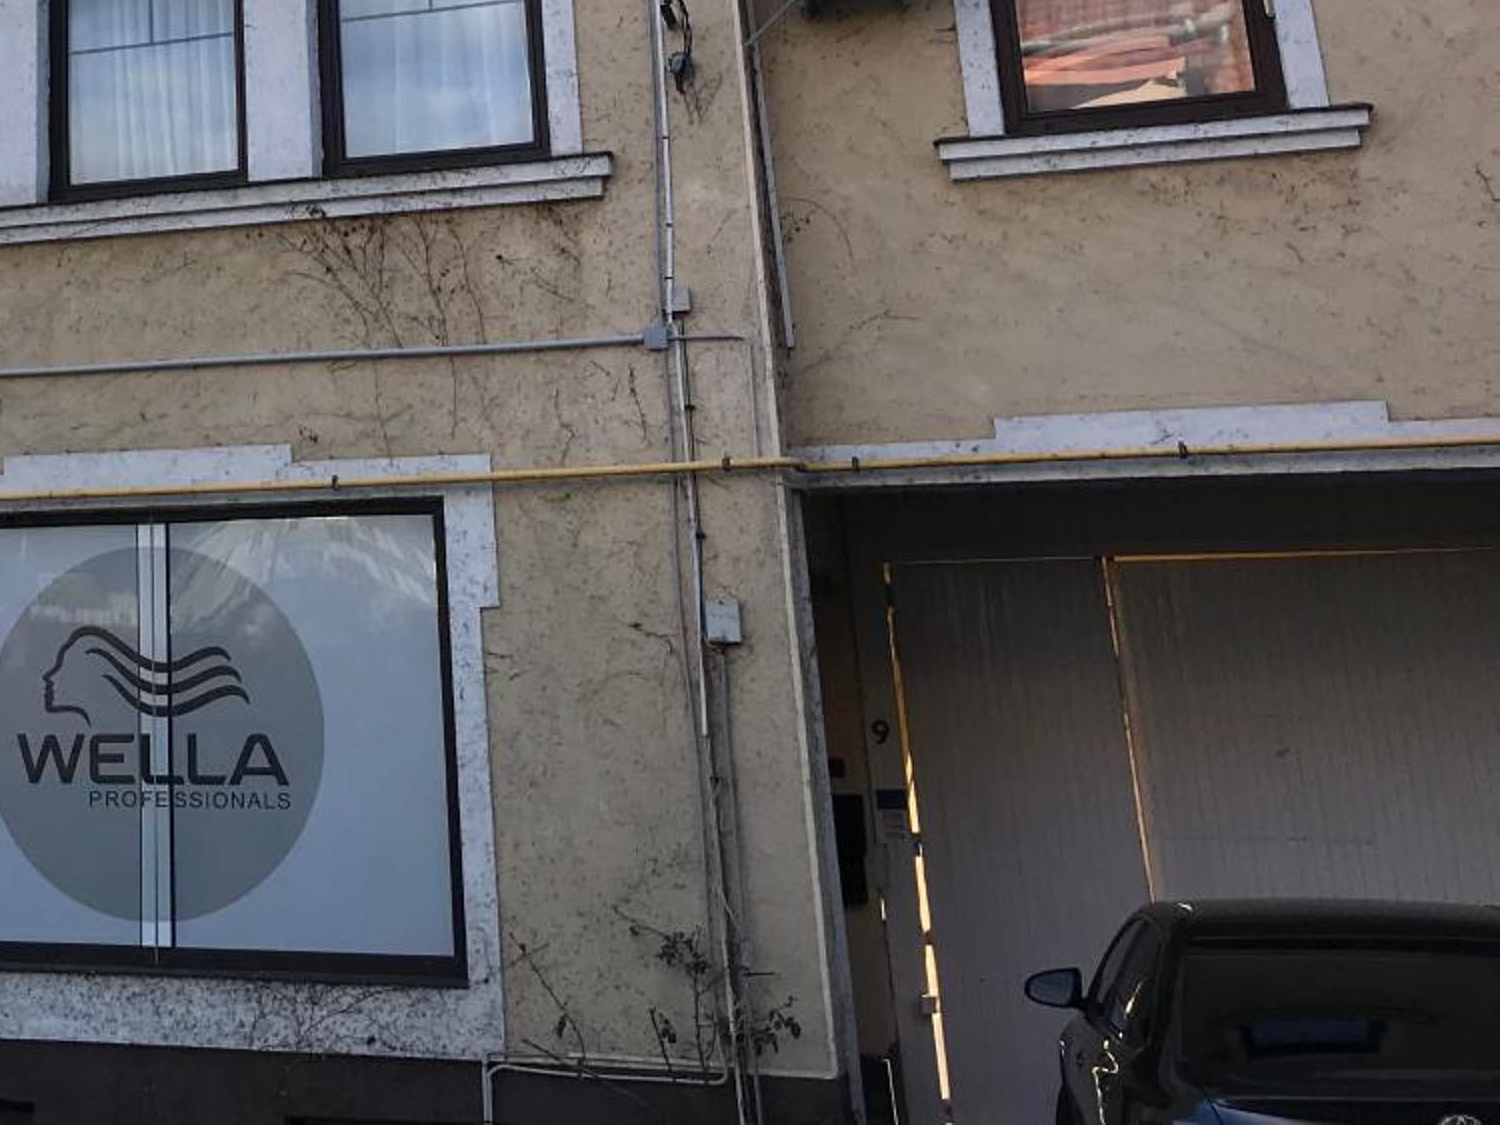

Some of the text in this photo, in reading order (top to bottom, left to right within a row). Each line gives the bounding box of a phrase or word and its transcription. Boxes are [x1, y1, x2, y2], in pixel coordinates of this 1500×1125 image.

[871, 720, 889, 745] 9
[17, 733, 290, 786] WELLA
[89, 790, 291, 810] PROFESSIONALS
